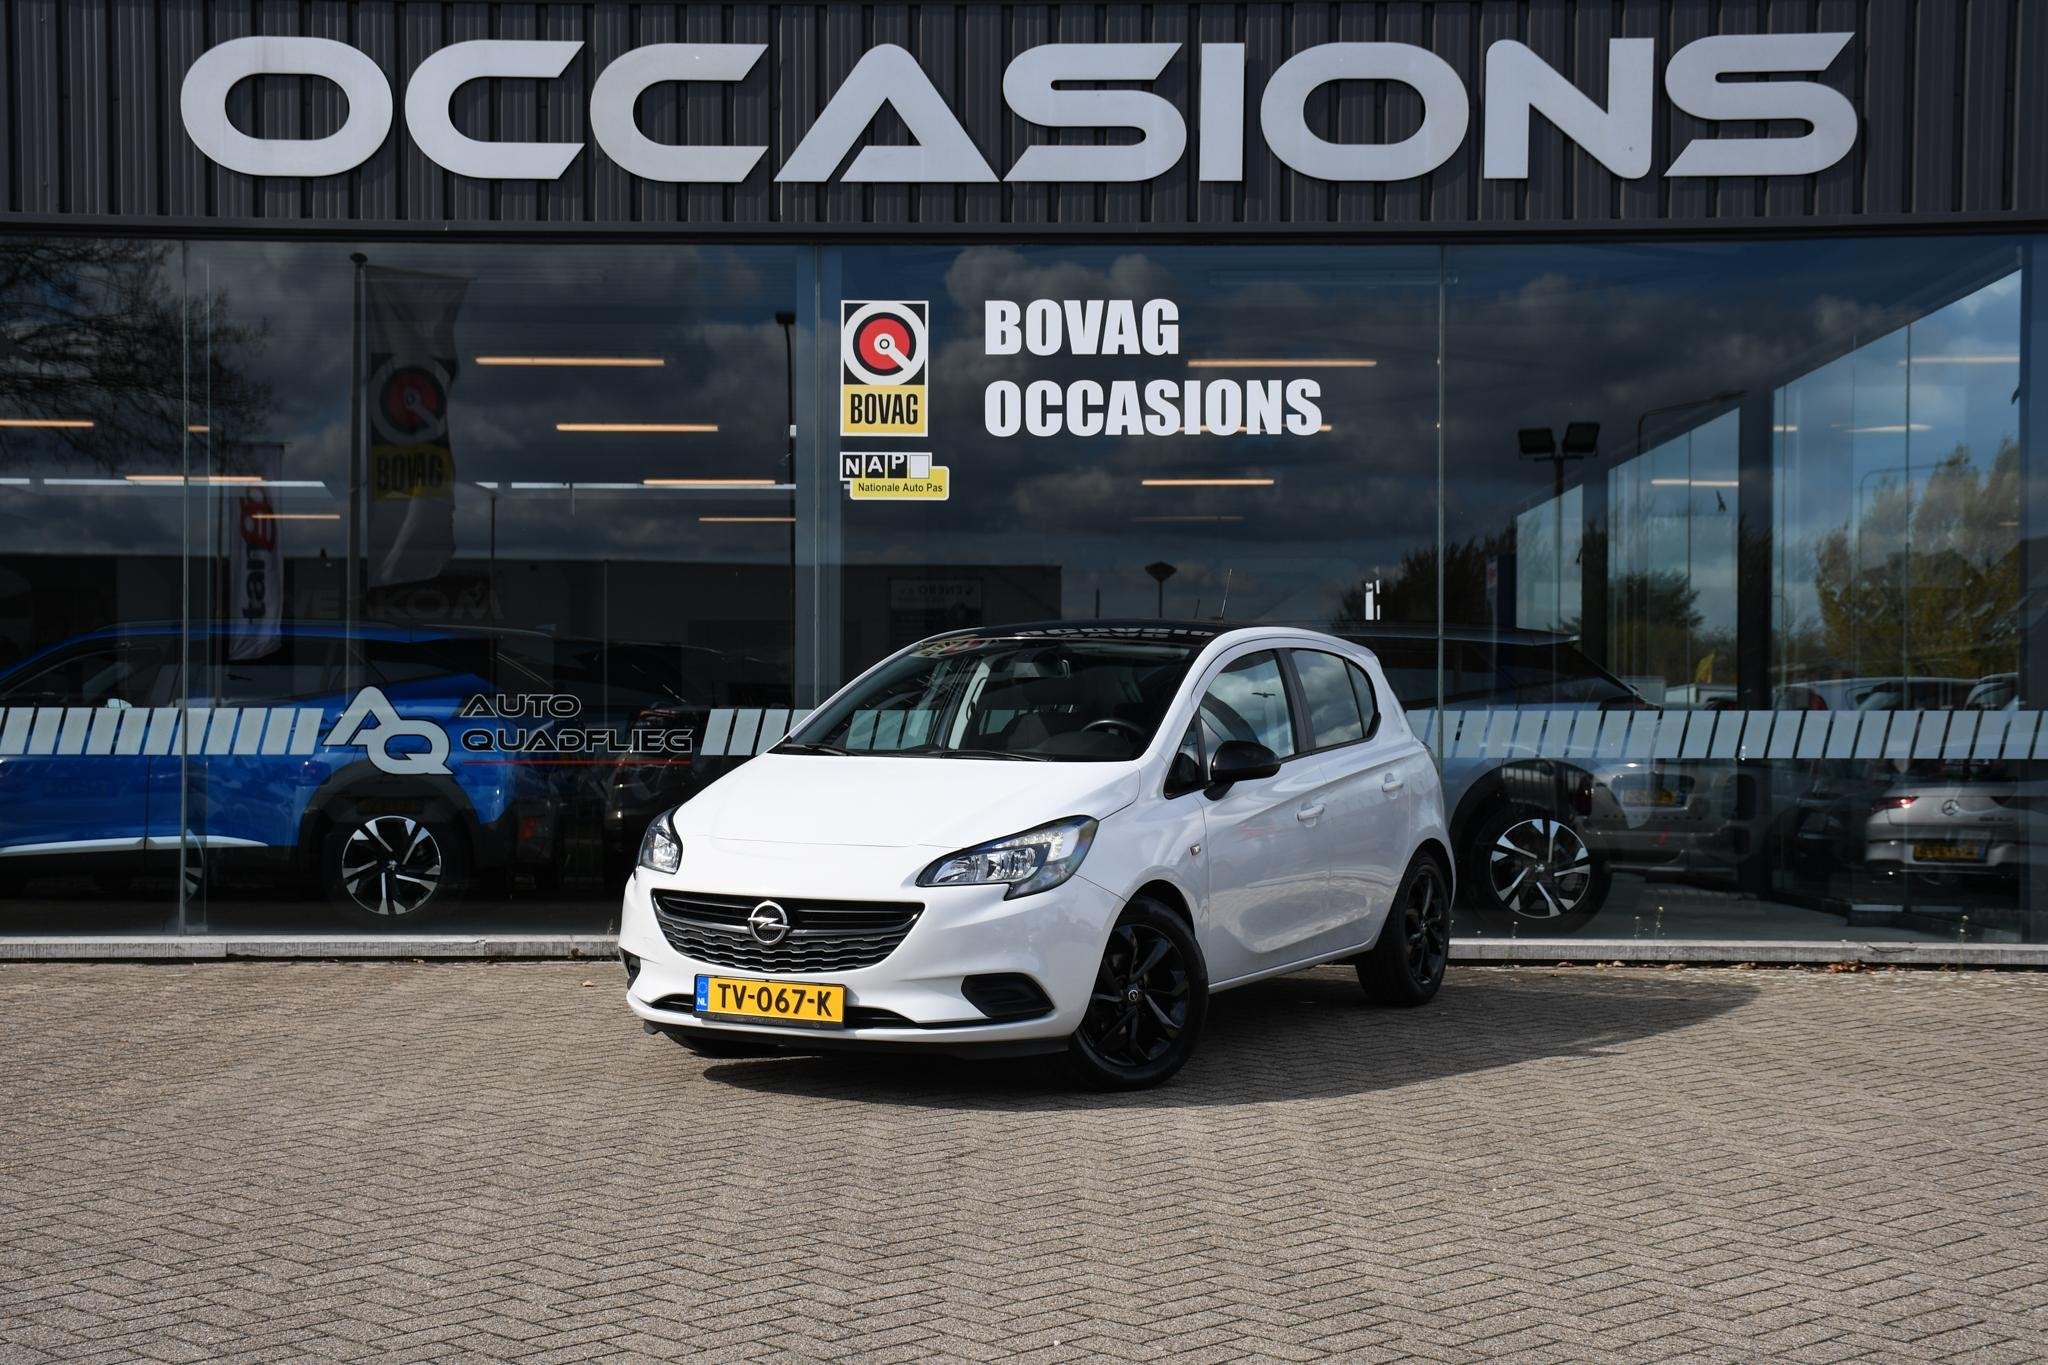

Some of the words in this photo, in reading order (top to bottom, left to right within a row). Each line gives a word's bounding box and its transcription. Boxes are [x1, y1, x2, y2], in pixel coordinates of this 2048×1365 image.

[181, 32, 1858, 182] OCCASIONS
[985, 298, 1179, 356] BOVAG
[850, 393, 918, 425] BOVAG
[985, 379, 1323, 437] OCCASIONS
[376, 452, 443, 491] BOVAG
[845, 454, 905, 475] NAP
[858, 482, 900, 492] Nationale
[902, 482, 924, 492] Auto
[926, 483, 943, 492] Pas
[460, 694, 581, 718] AUTO
[321, 686, 453, 774] AQ
[461, 728, 693, 753] QUADFLIEG
[697, 997, 707, 1006] NL
[717, 983, 832, 1017] TV-067-K
